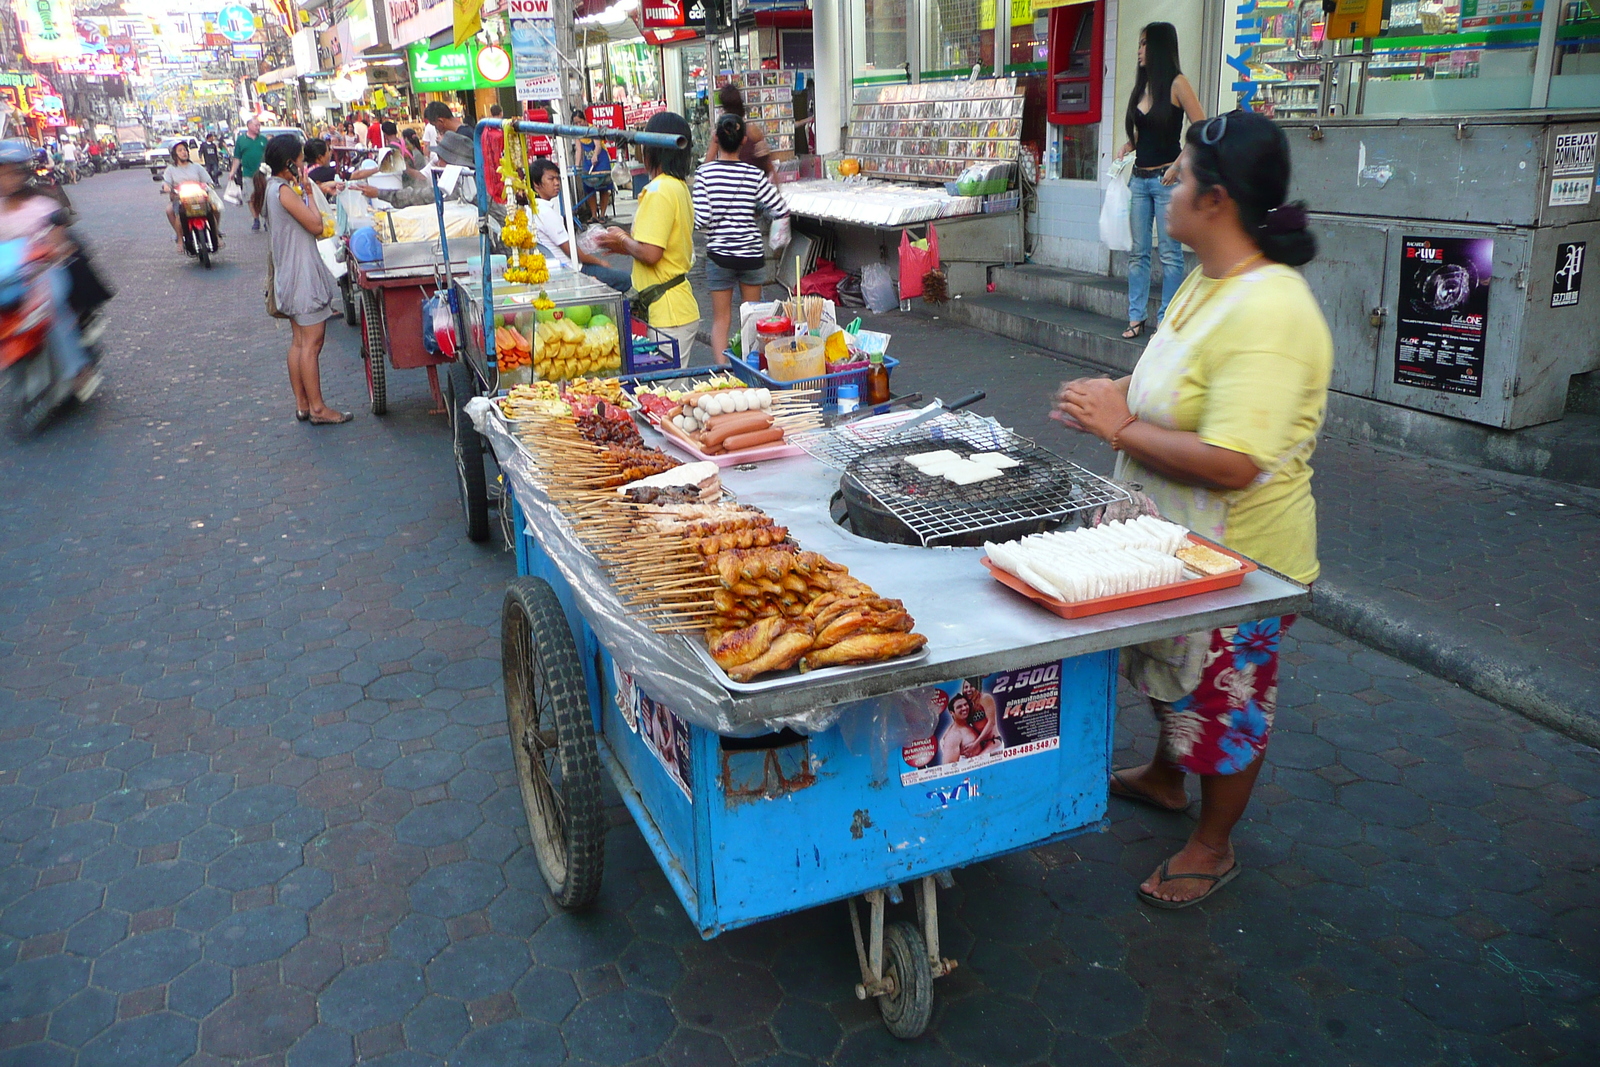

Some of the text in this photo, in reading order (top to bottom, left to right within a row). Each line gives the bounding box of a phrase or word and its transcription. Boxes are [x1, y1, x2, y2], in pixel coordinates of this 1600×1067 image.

[511, 0, 549, 13] NOW
[646, 7, 677, 20] PUMA
[440, 54, 467, 68] ATM
[592, 106, 614, 118] NEW
[1557, 134, 1597, 147] DEEJAY
[992, 665, 1059, 694] 2,500
[1002, 696, 1058, 720] 14,999
[1003, 739, 1058, 758] 038-488-548/9
